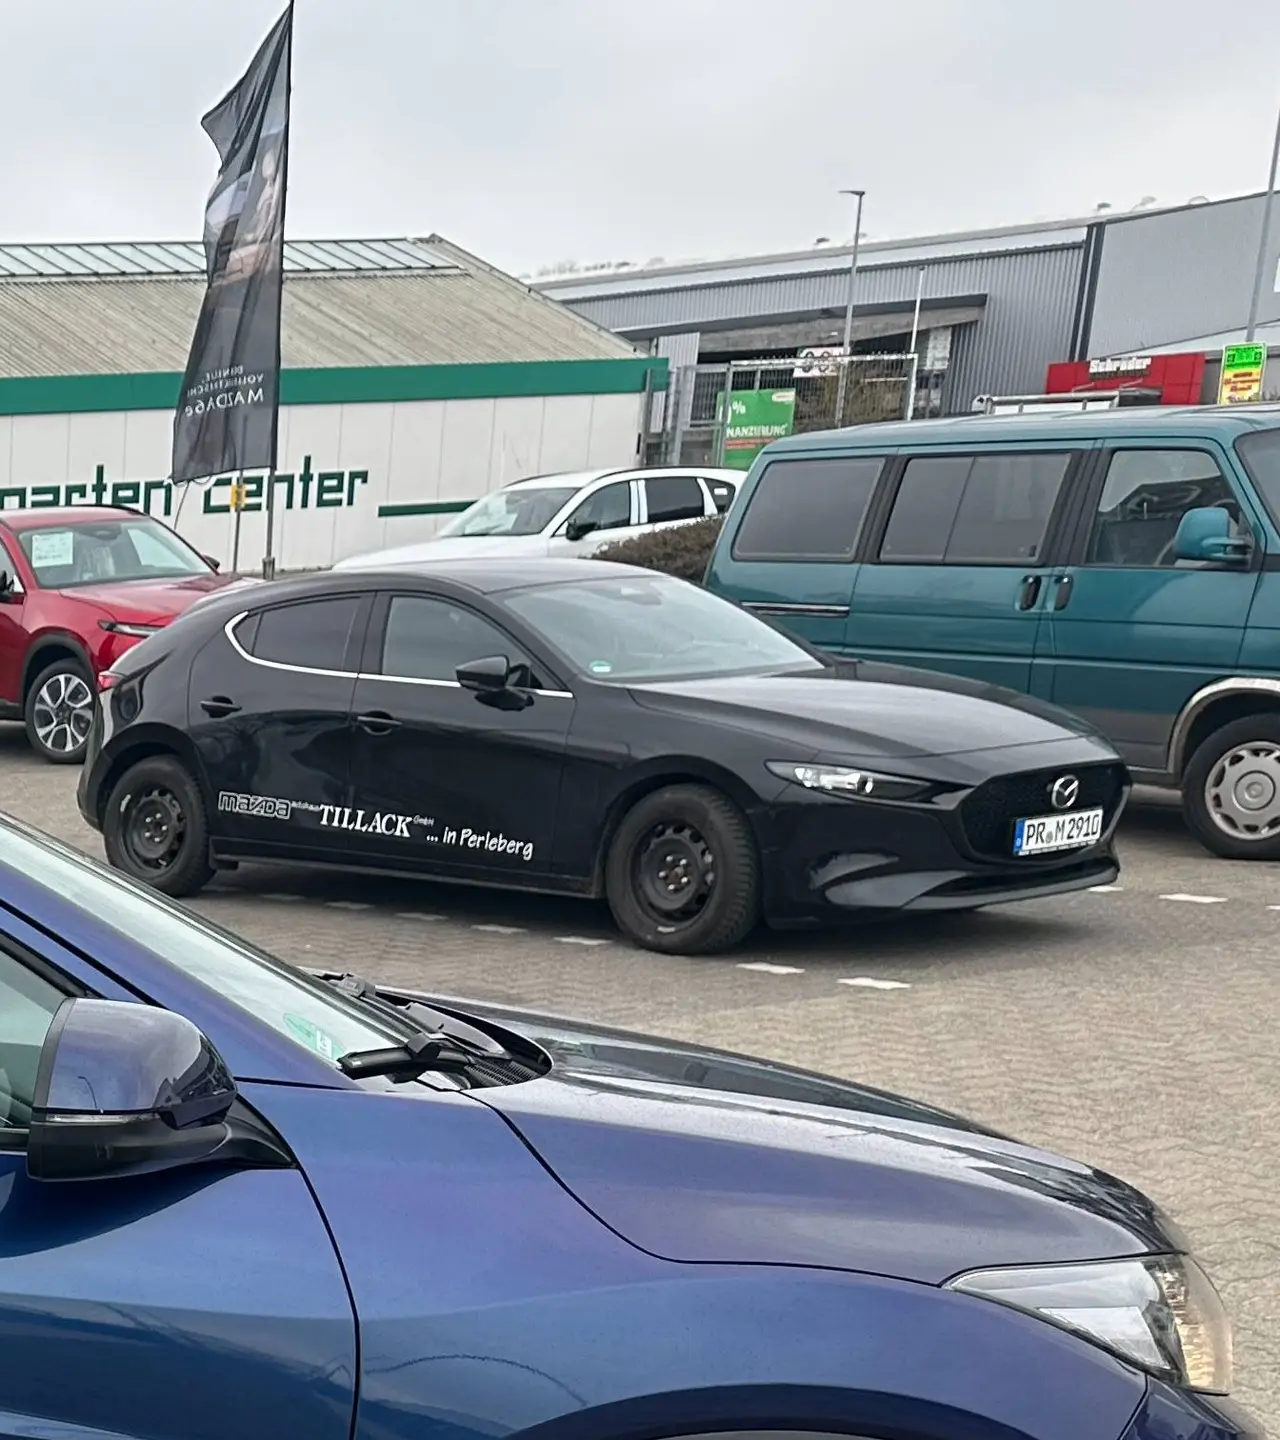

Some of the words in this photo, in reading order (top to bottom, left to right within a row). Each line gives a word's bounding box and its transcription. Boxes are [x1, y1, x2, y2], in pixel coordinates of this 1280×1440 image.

[203, 455, 369, 514] center
[218, 791, 291, 820] mazda
[320, 804, 413, 838] TILLACK
[1026, 822, 1046, 845] PR
[1066, 814, 1100, 840] 2910
[459, 828, 534, 861] Perleberg
